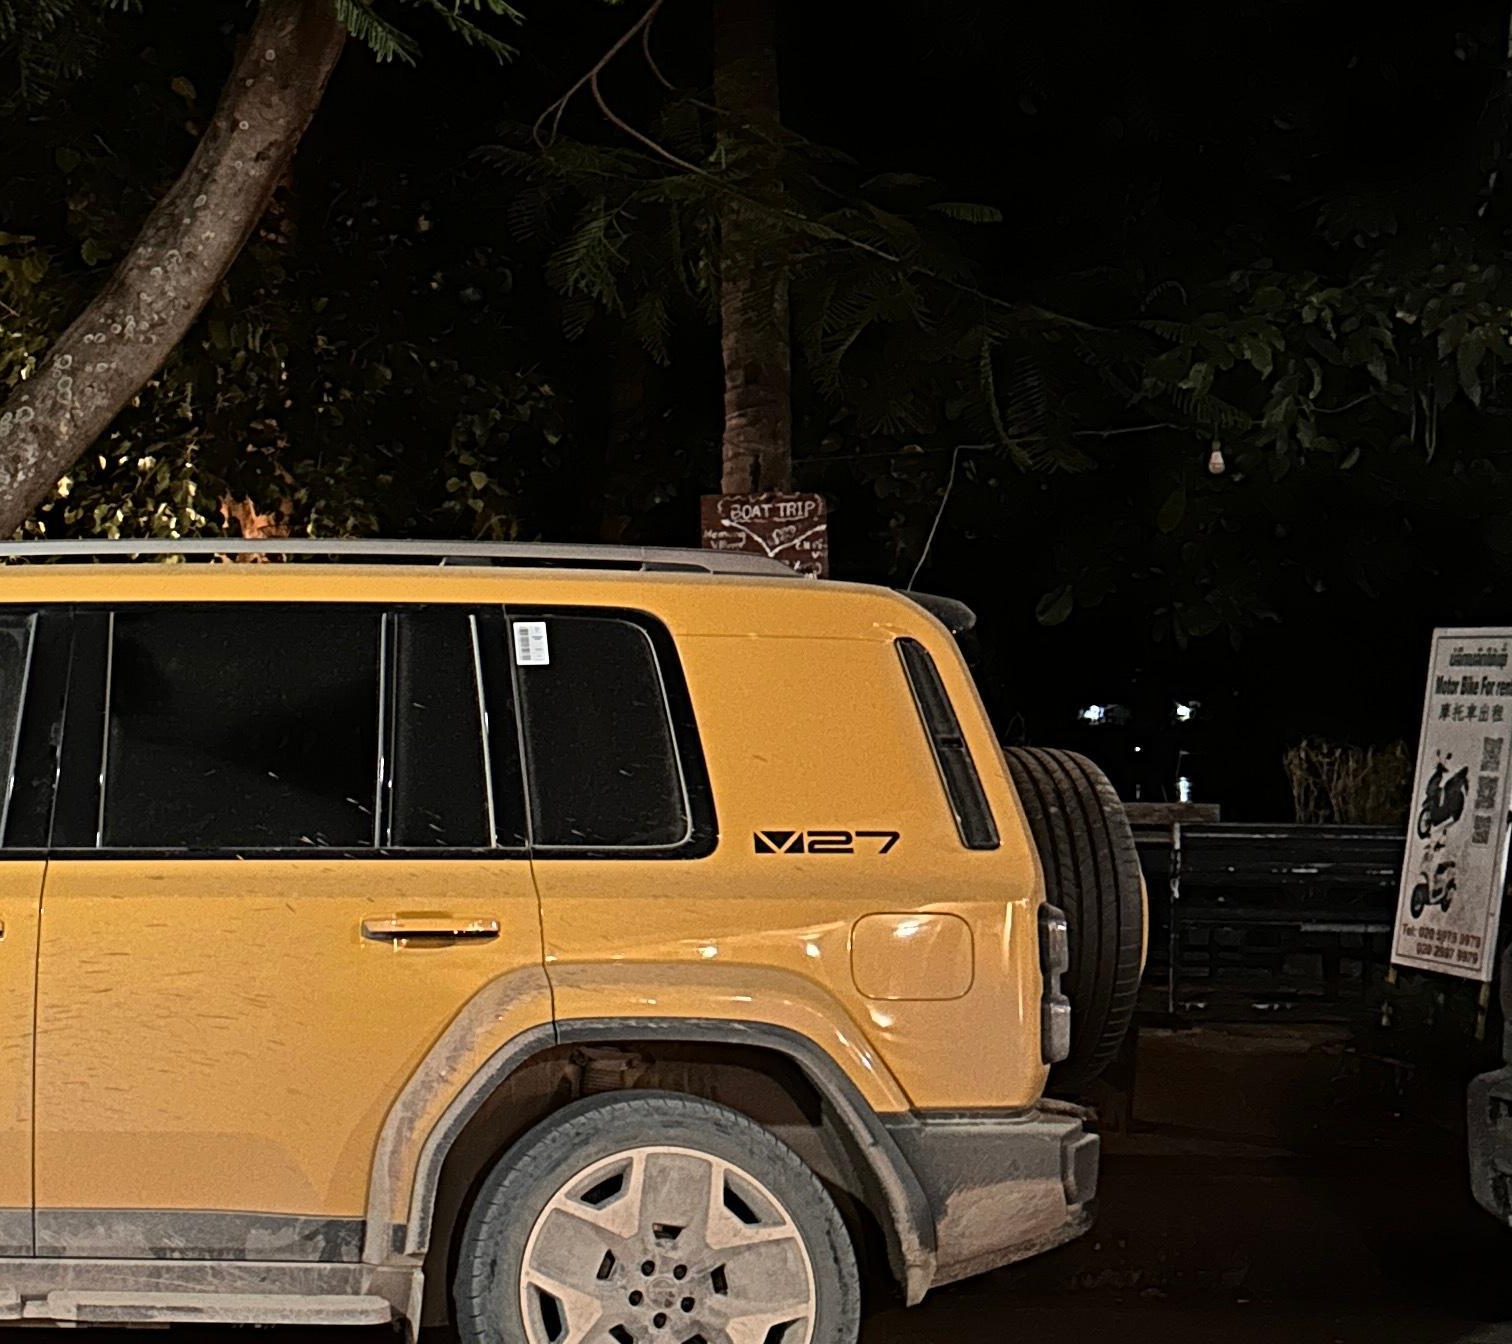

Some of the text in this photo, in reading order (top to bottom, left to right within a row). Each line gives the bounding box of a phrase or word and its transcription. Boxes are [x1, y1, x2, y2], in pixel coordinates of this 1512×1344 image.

[730, 500, 816, 520] BOAT TRIP
[1435, 675, 1460, 695] Motor
[1461, 675, 1480, 695] Bike
[1480, 675, 1496, 696] For
